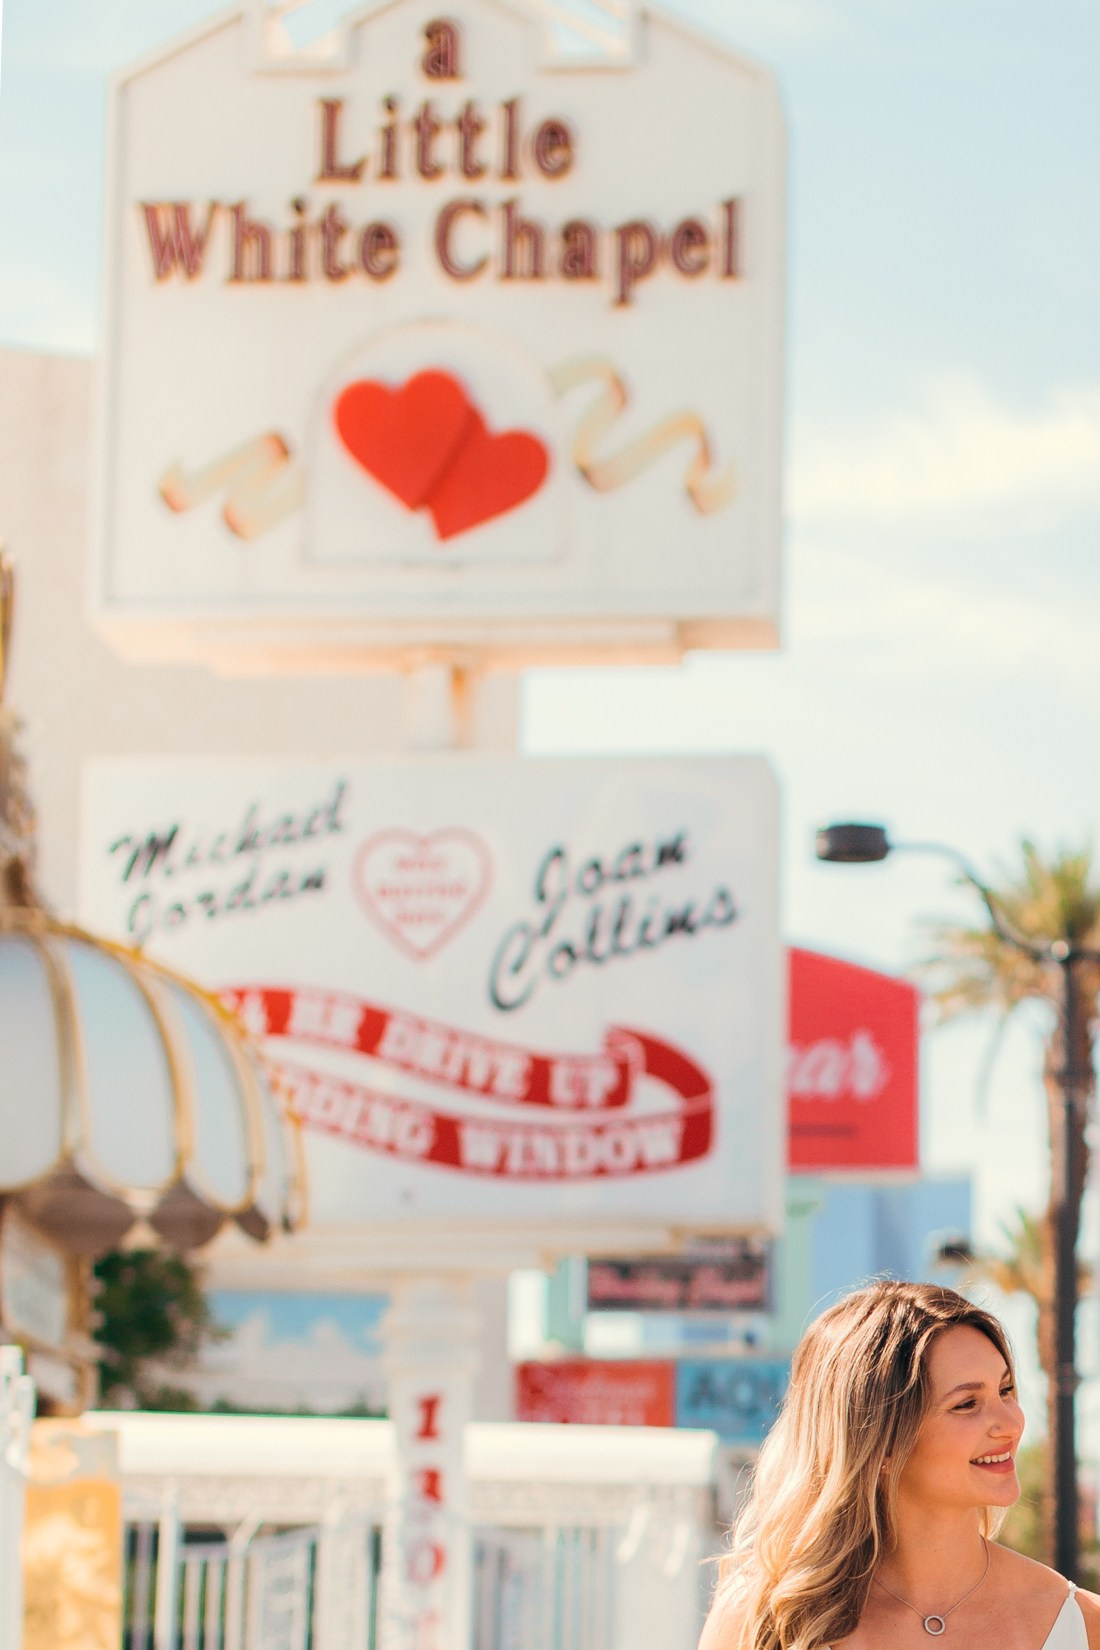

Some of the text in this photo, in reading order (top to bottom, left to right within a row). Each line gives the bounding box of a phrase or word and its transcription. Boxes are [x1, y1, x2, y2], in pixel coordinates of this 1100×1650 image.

[422, 18, 463, 81] a
[314, 97, 573, 181] Little
[138, 199, 742, 308] White Chapel
[108, 779, 347, 882] Michael
[126, 866, 326, 948] Jordan
[534, 831, 688, 938] Joan
[488, 884, 739, 1012] Collins
[378, 1010, 530, 1105] DRIVE
[549, 1056, 619, 1110] UP
[459, 1116, 682, 1178] WINDOW
